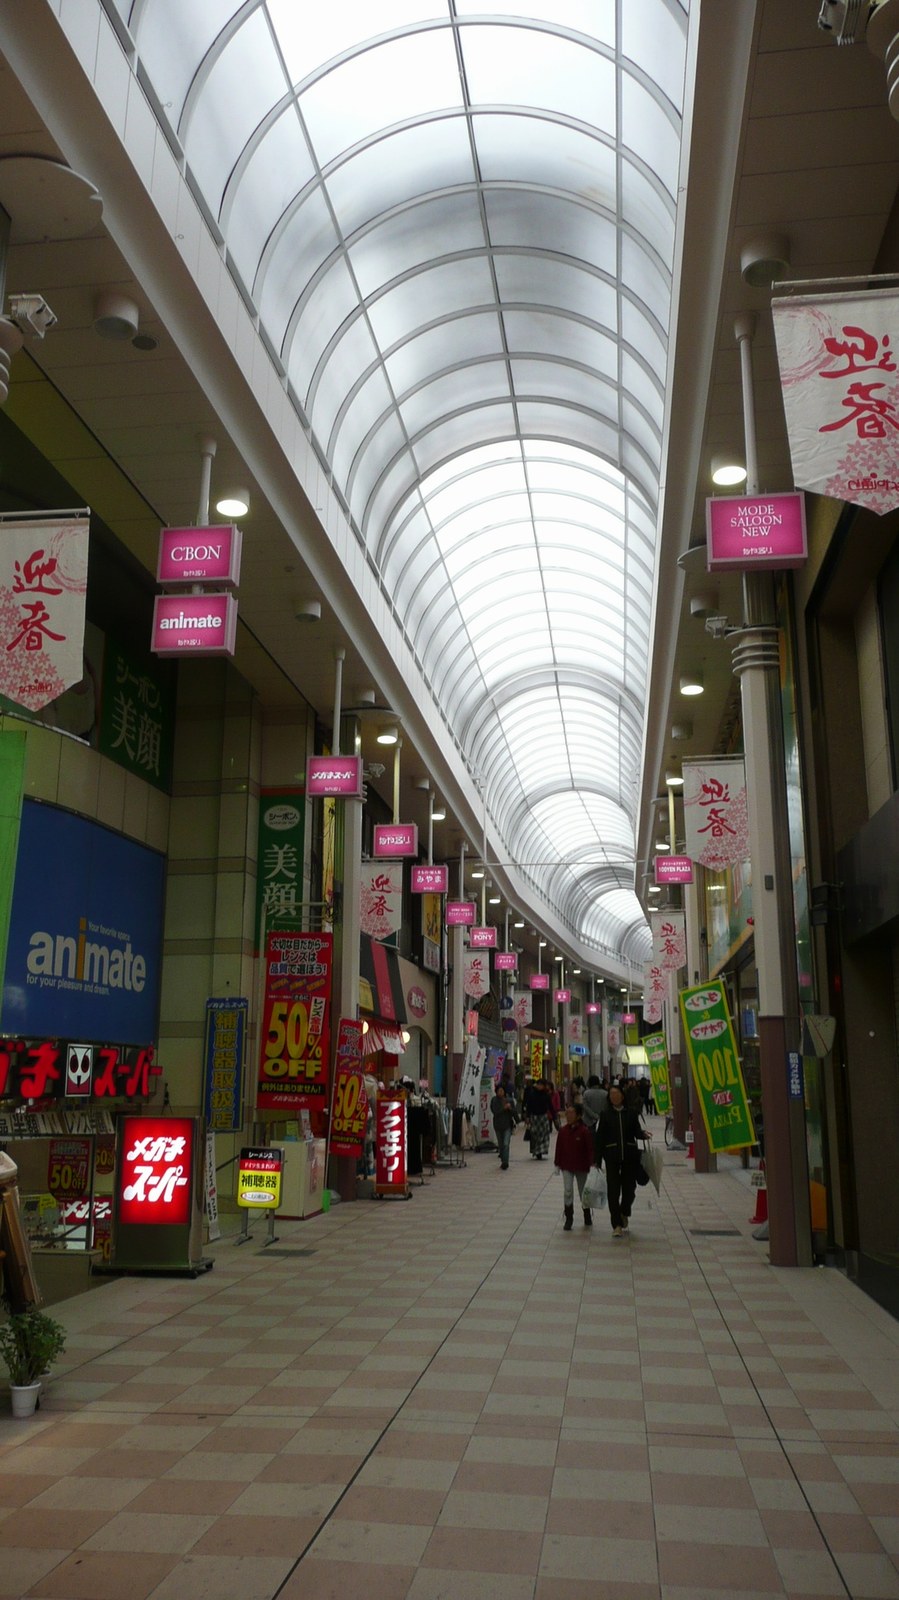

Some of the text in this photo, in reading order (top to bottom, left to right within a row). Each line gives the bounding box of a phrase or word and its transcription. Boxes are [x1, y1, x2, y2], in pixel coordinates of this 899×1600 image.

[731, 515, 782, 527] SALOON
[738, 504, 775, 516] MODE
[742, 526, 771, 537] NEW
[6, 549, 66, 651] 迎春
[160, 611, 222, 629] animate
[110, 690, 162, 777] 美顔
[263, 843, 298, 916] 美顔
[416, 875, 442, 883] みやま
[367, 873, 394, 917] 迎春
[26, 917, 147, 993] animate
[281, 951, 318, 963] レンズは
[26, 974, 38, 984] for
[40, 977, 57, 988] your
[469, 958, 485, 985] 迎春
[265, 1001, 321, 1060] 50%
[94, 1045, 163, 1097] スーパー
[211, 1011, 239, 1130] 補聴器取扱店
[263, 1059, 322, 1078] OFF
[261, 1082, 321, 1094] 例外はありません!
[335, 1074, 366, 1120] 50%
[333, 1118, 364, 1133] OFF
[127, 1136, 186, 1162] メガネ
[380, 1101, 402, 1182] アクセサリー
[72, 1179, 86, 1190] OFF
[124, 1165, 188, 1202] スーパー
[241, 1174, 277, 1189] 補聴器
